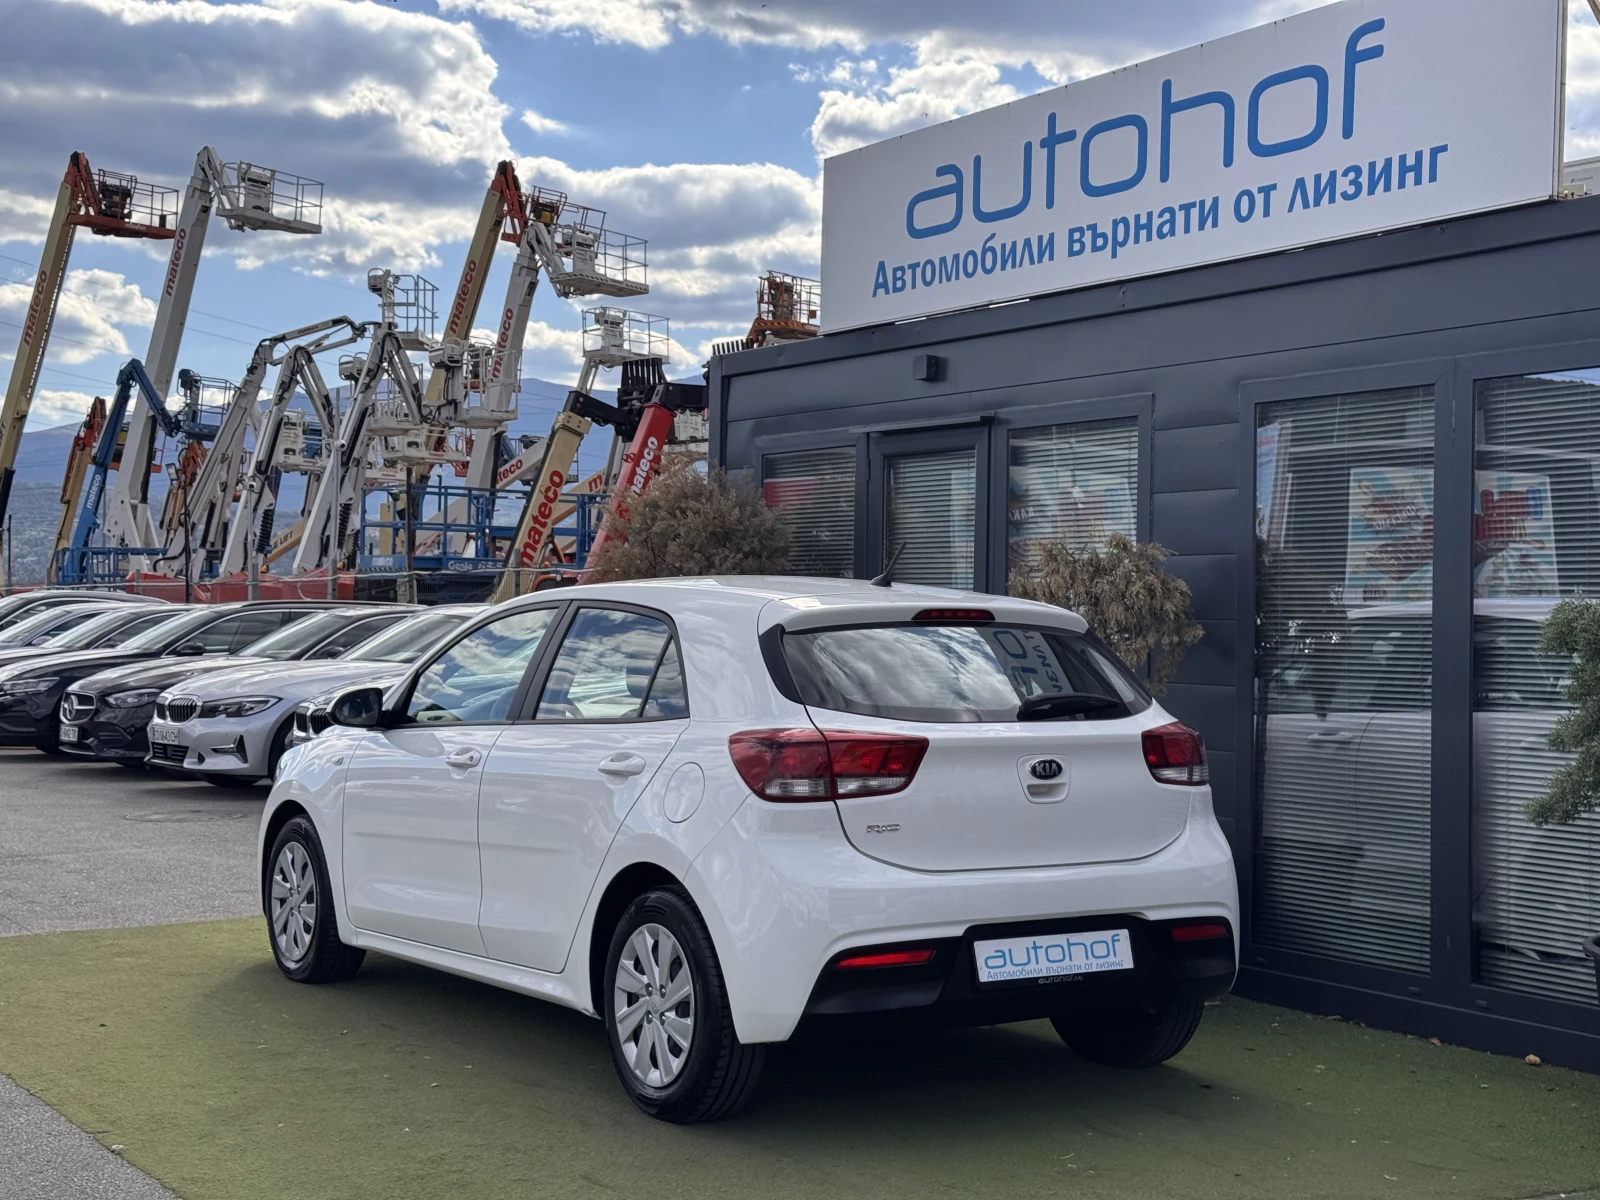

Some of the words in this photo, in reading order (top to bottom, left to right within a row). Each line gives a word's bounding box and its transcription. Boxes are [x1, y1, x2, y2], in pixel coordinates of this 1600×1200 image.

[906, 18, 1385, 239] autohof
[873, 232, 1056, 297] Автомобили
[1067, 196, 1220, 259] върнати
[1233, 183, 1278, 223] от
[1288, 144, 1449, 213] лизинг
[165, 228, 187, 297] mateco
[24, 270, 47, 347] mateco
[449, 260, 477, 335] mateco
[86, 474, 101, 509] mateco
[497, 459, 523, 484] teco
[520, 469, 564, 568] mateco
[1035, 762, 1059, 776] KIA
[984, 933, 1121, 970] autohof
[987, 966, 1043, 980] Автомобили
[1045, 963, 1082, 976] върнати
[1084, 961, 1094, 971] от
[1095, 959, 1124, 970] лизинг
